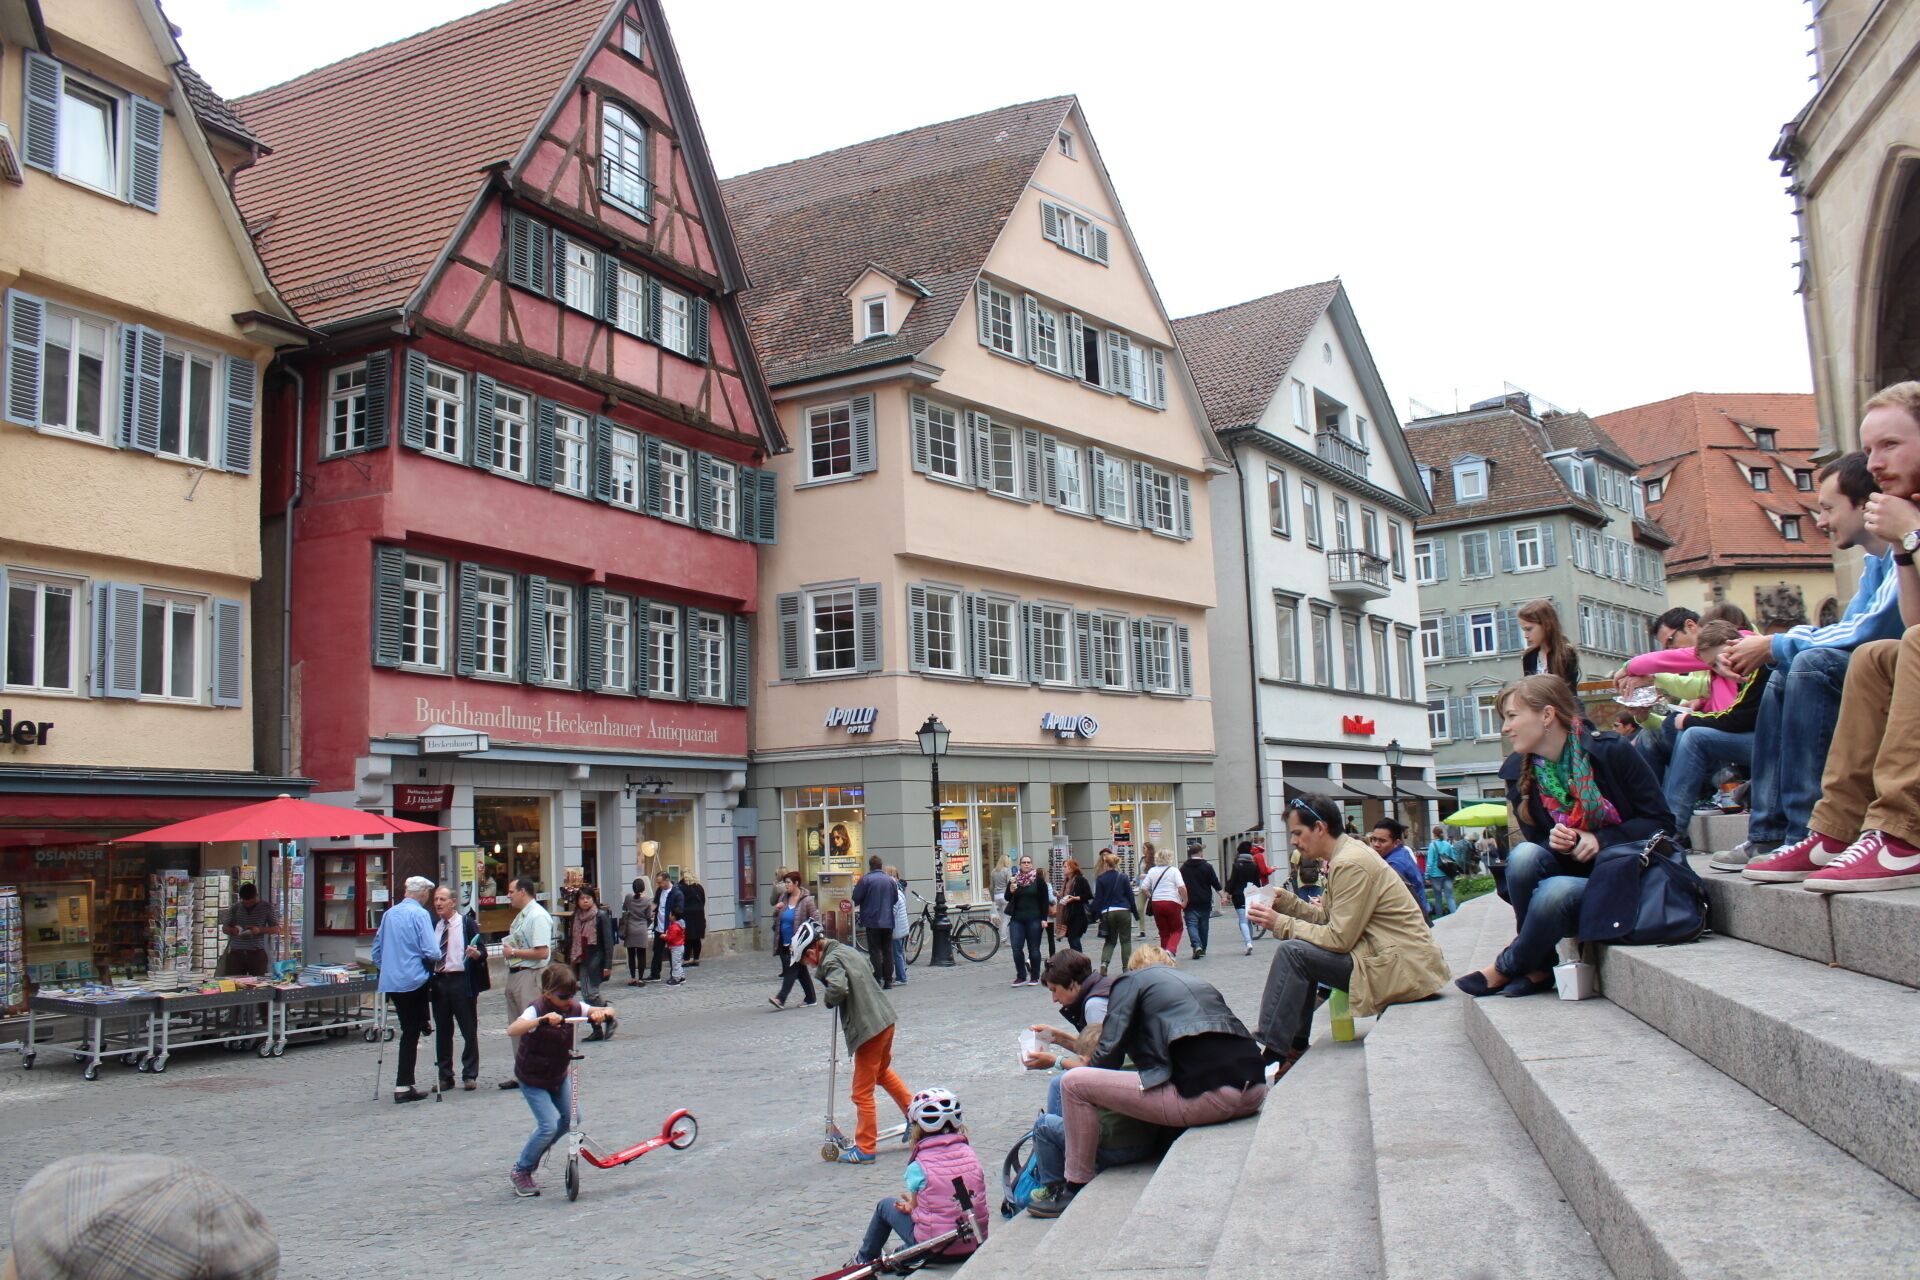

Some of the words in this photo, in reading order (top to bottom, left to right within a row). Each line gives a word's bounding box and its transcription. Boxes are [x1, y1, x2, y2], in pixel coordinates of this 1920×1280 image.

[415, 697, 542, 738] Buchhandlung
[546, 711, 643, 738] Heckenhauer
[647, 717, 719, 747] Antiquariat
[824, 707, 876, 727] APOLLO
[1046, 712, 1078, 731] APOLLO
[847, 724, 871, 734] OPTIK
[427, 740, 474, 749] Heckenhauer
[35, 850, 103, 861] OSIANDER
